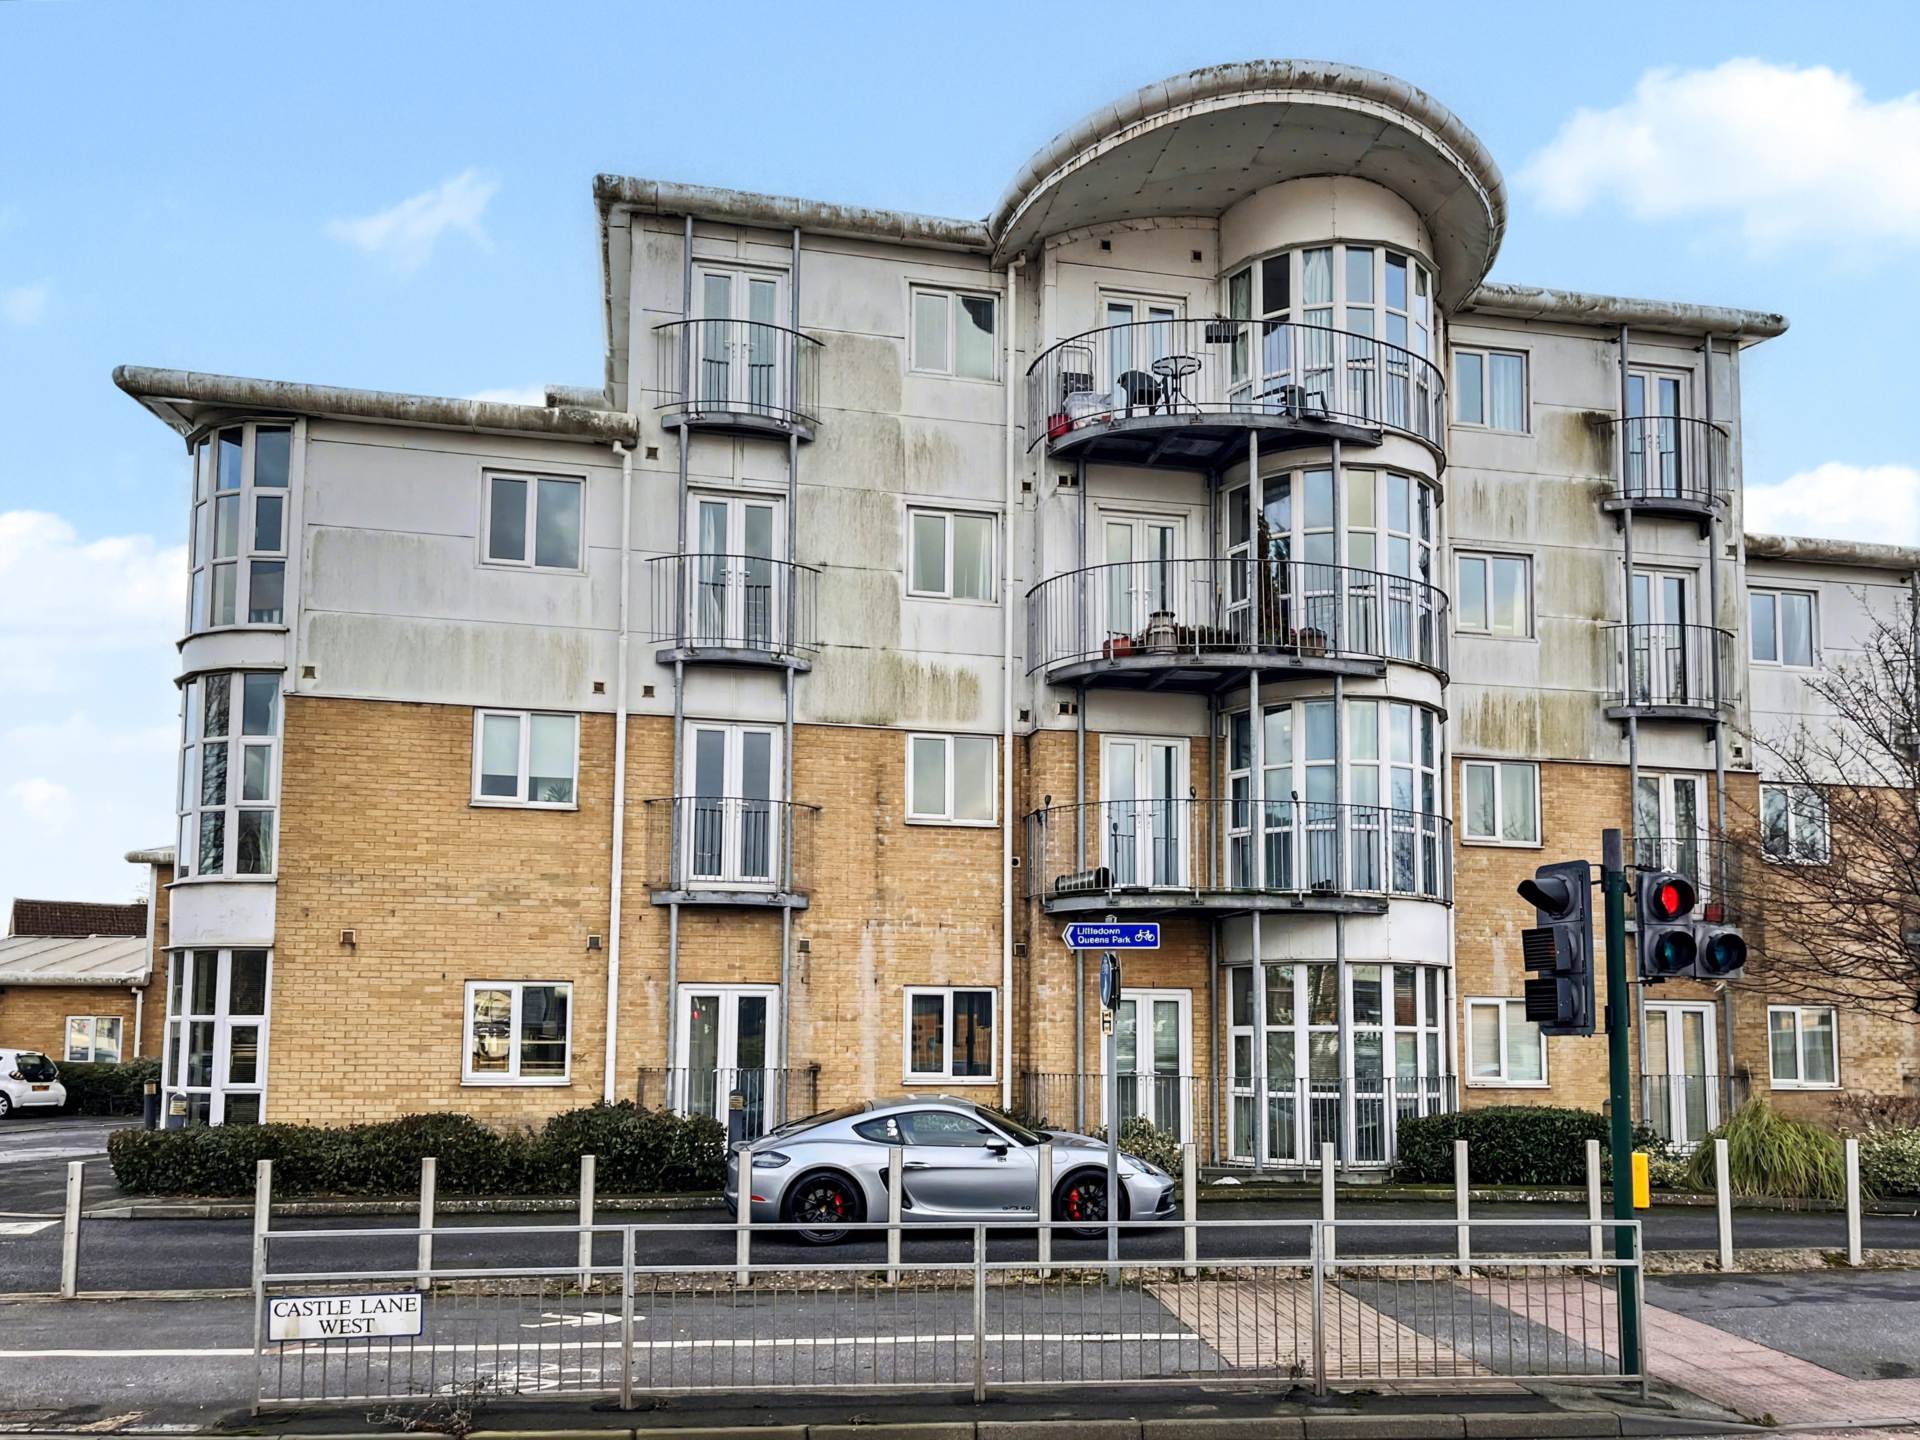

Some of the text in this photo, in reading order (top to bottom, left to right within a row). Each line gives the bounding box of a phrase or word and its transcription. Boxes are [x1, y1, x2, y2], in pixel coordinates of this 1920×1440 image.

[1077, 927, 1121, 935] Littledown
[1078, 936, 1131, 944] Queens Park
[274, 1297, 417, 1318] CASTLE LANE
[319, 1317, 375, 1335] WEST
